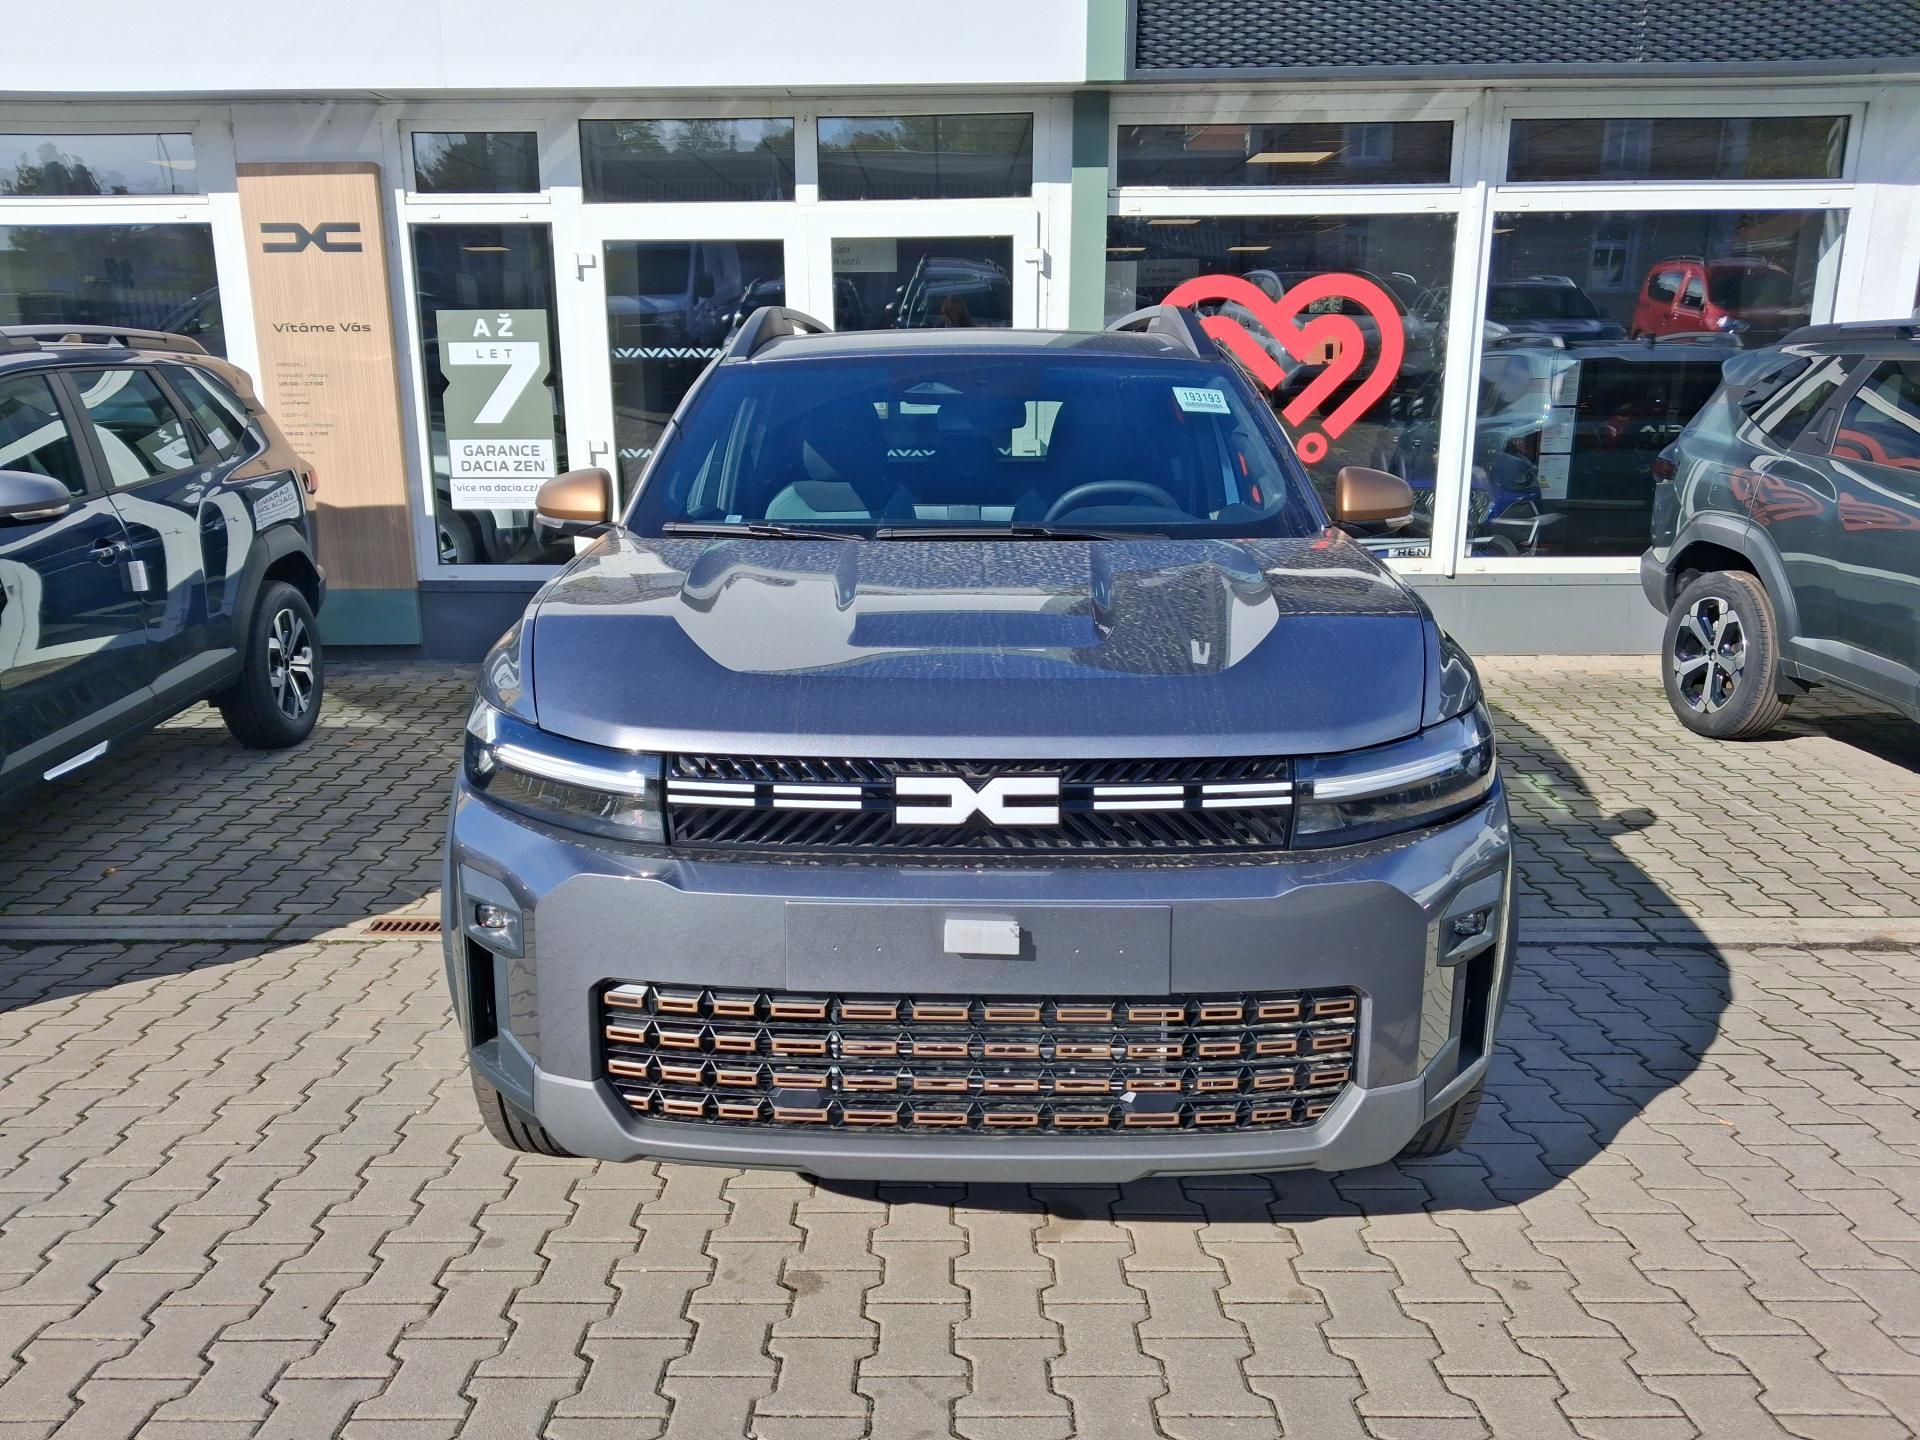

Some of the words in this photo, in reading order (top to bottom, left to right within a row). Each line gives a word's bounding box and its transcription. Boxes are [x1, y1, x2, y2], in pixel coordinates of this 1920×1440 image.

[272, 322, 335, 333] Vítáme
[339, 322, 372, 332] Vás
[473, 313, 514, 337] AŽ
[476, 349, 512, 359] LET
[448, 342, 541, 424] 7
[1183, 391, 1222, 404] 193193
[463, 445, 541, 457] GARANCE
[460, 460, 510, 472] DACIA
